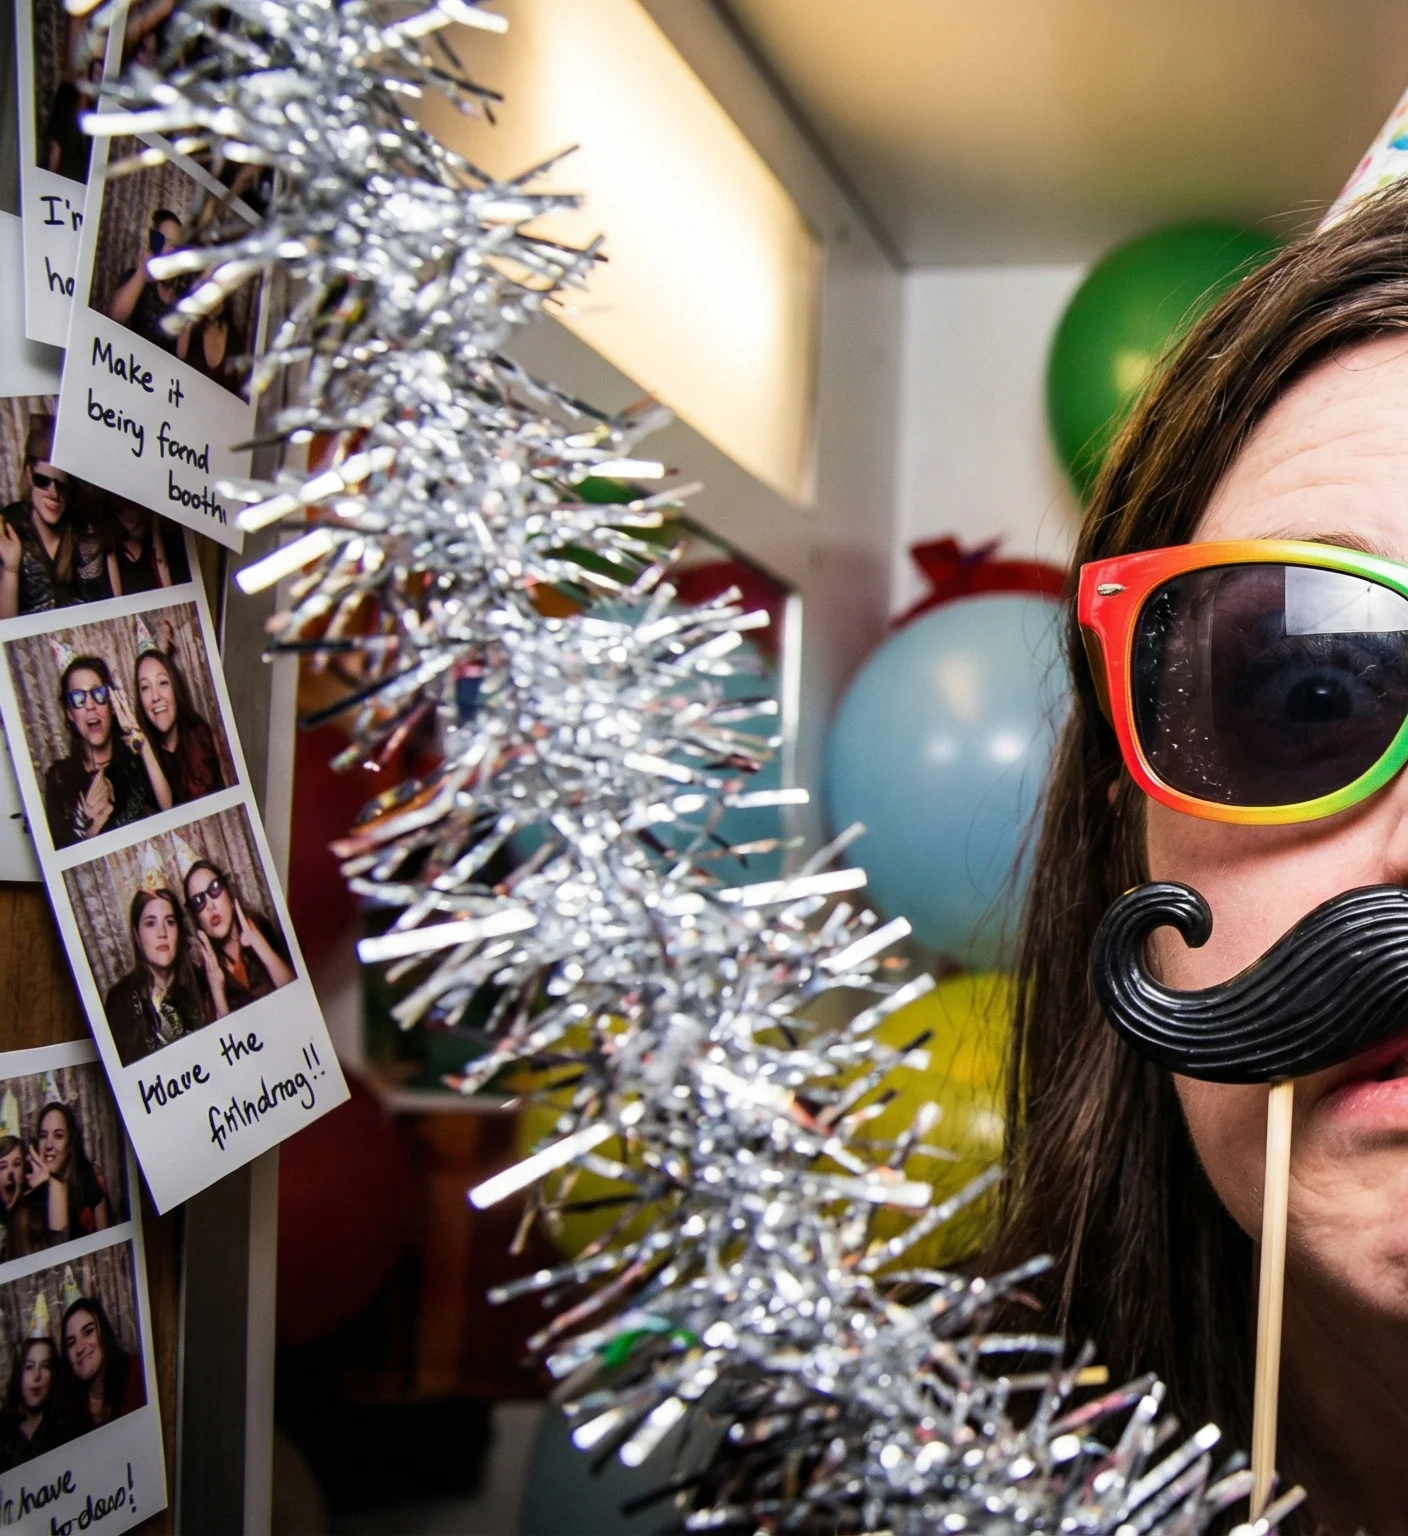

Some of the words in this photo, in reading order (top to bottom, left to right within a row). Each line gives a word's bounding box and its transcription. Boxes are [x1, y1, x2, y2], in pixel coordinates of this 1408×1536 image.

[92, 336, 155, 393] Make
[168, 378, 185, 408] it
[219, 1032, 264, 1066] the
